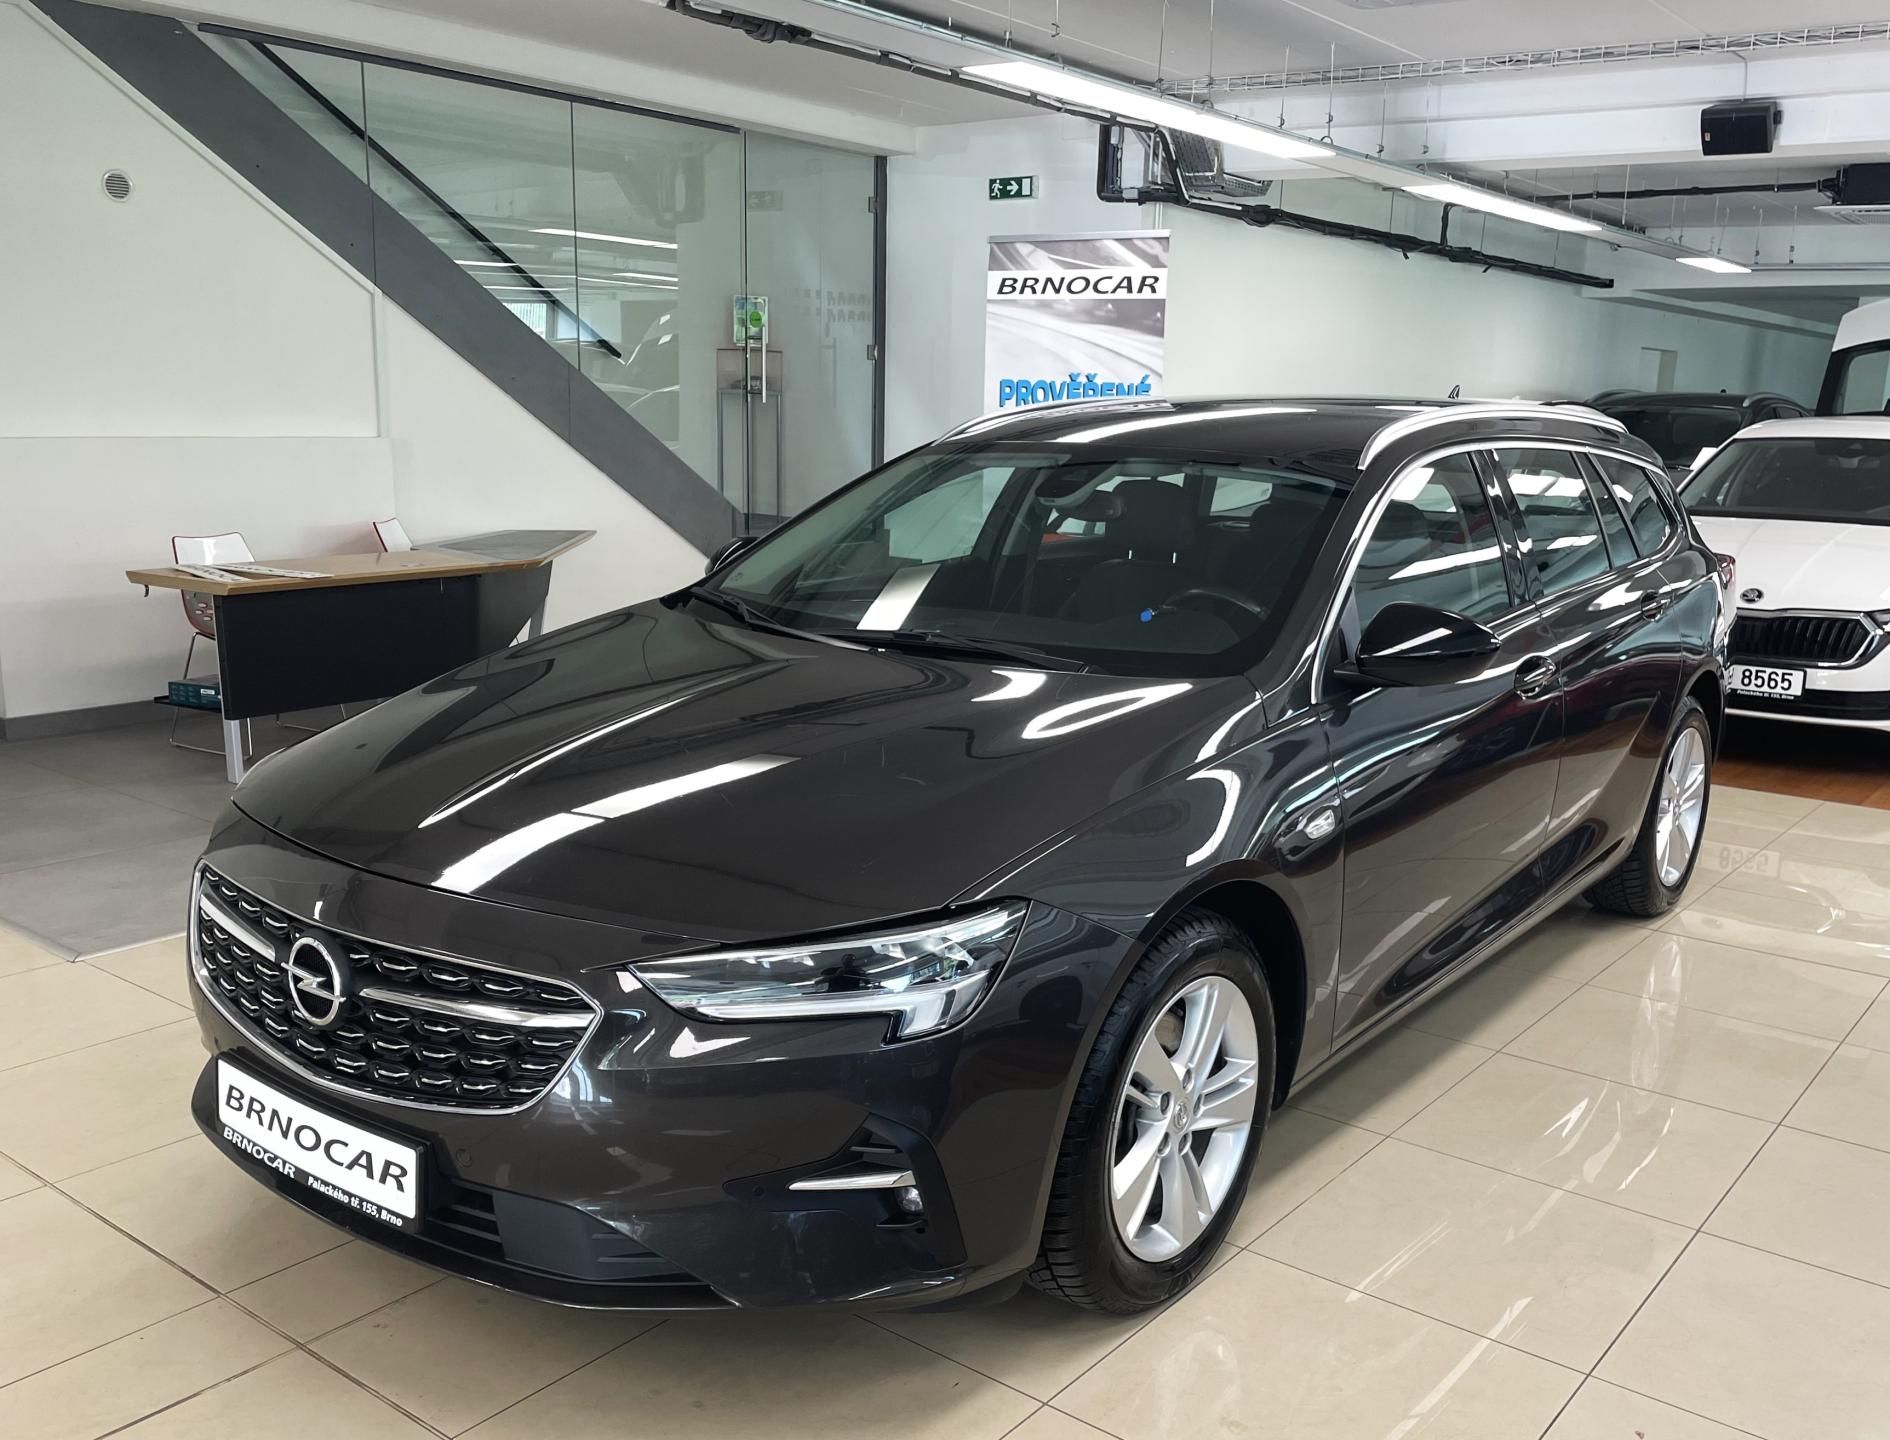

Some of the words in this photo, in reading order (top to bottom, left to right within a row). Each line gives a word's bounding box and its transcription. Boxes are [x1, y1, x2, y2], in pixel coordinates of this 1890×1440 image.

[997, 275, 1160, 295] BRNOCAR
[1741, 669, 1793, 691] 8565
[225, 1084, 408, 1194] BRNOCAR
[223, 1126, 296, 1179] BRNOCAR
[307, 1175, 350, 1204] Palackého
[350, 1195, 361, 1209] tř.
[361, 1200, 380, 1219] 155,
[380, 1208, 403, 1227] Brno
